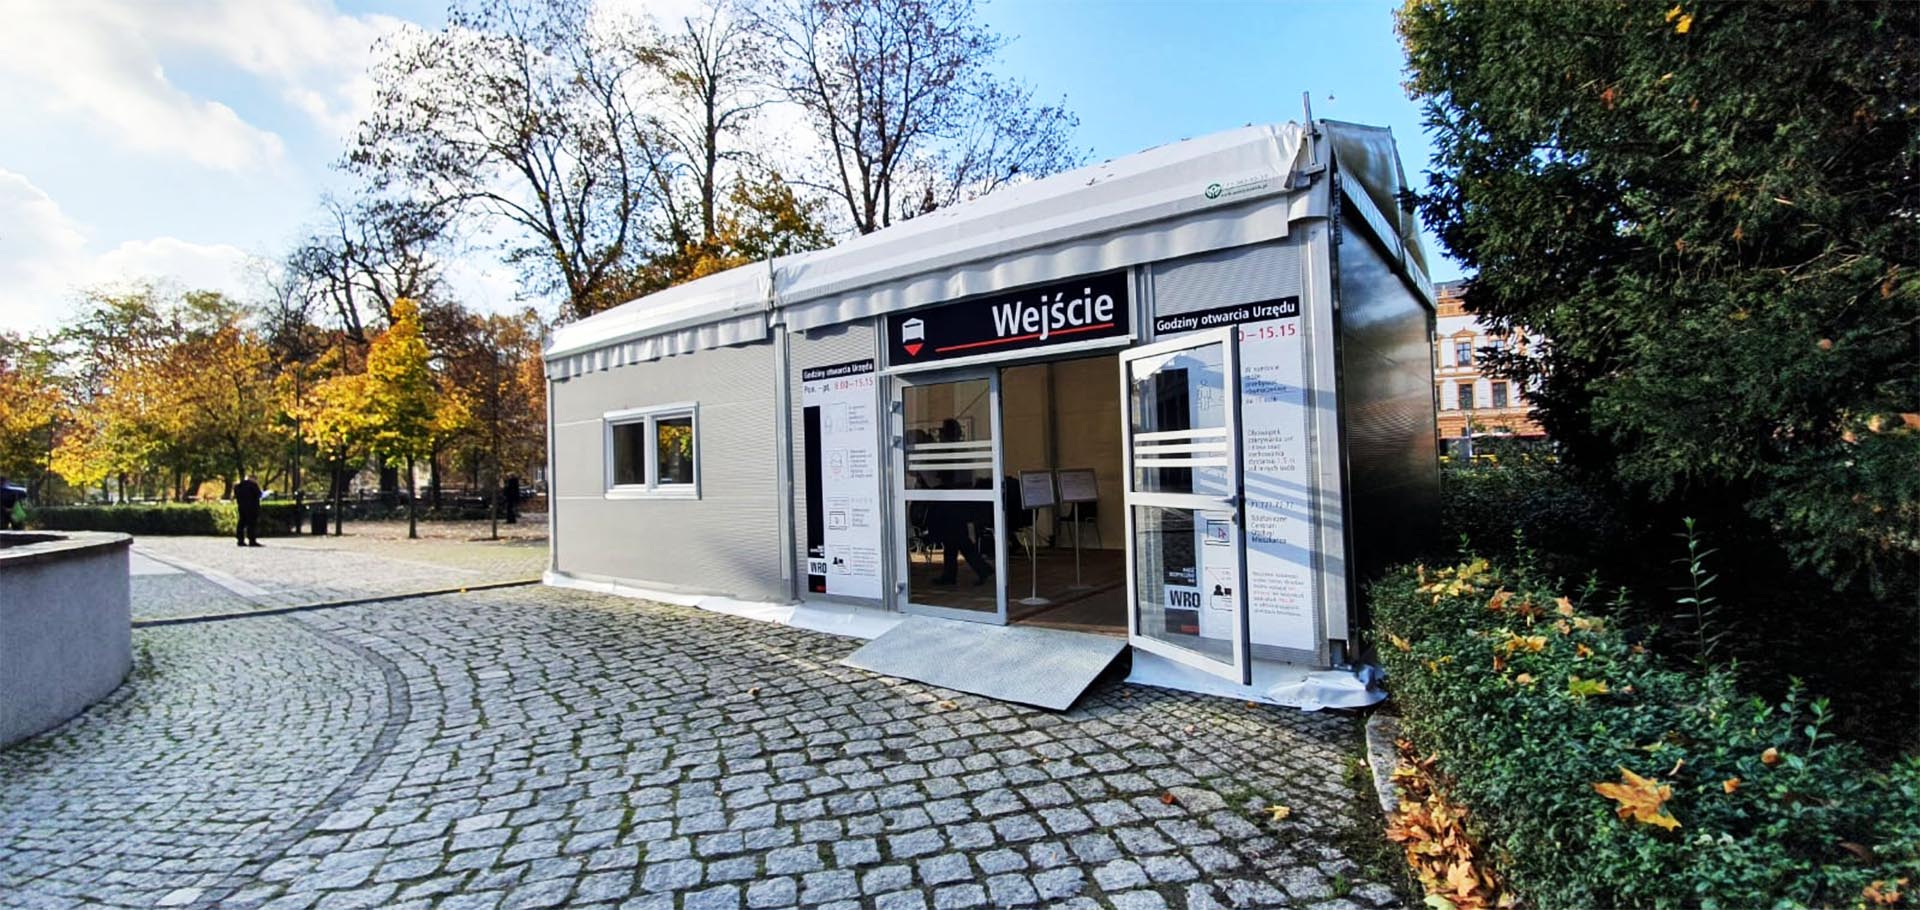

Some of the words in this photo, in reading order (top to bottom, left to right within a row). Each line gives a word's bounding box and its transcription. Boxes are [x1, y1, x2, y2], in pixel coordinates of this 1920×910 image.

[992, 287, 1114, 341] Wejście
[1156, 316, 1198, 332] Godziny
[1201, 309, 1250, 325] otwarcia
[1252, 300, 1296, 318] Urzędu
[803, 370, 825, 380] Godziny
[1169, 589, 1201, 608] WRO
